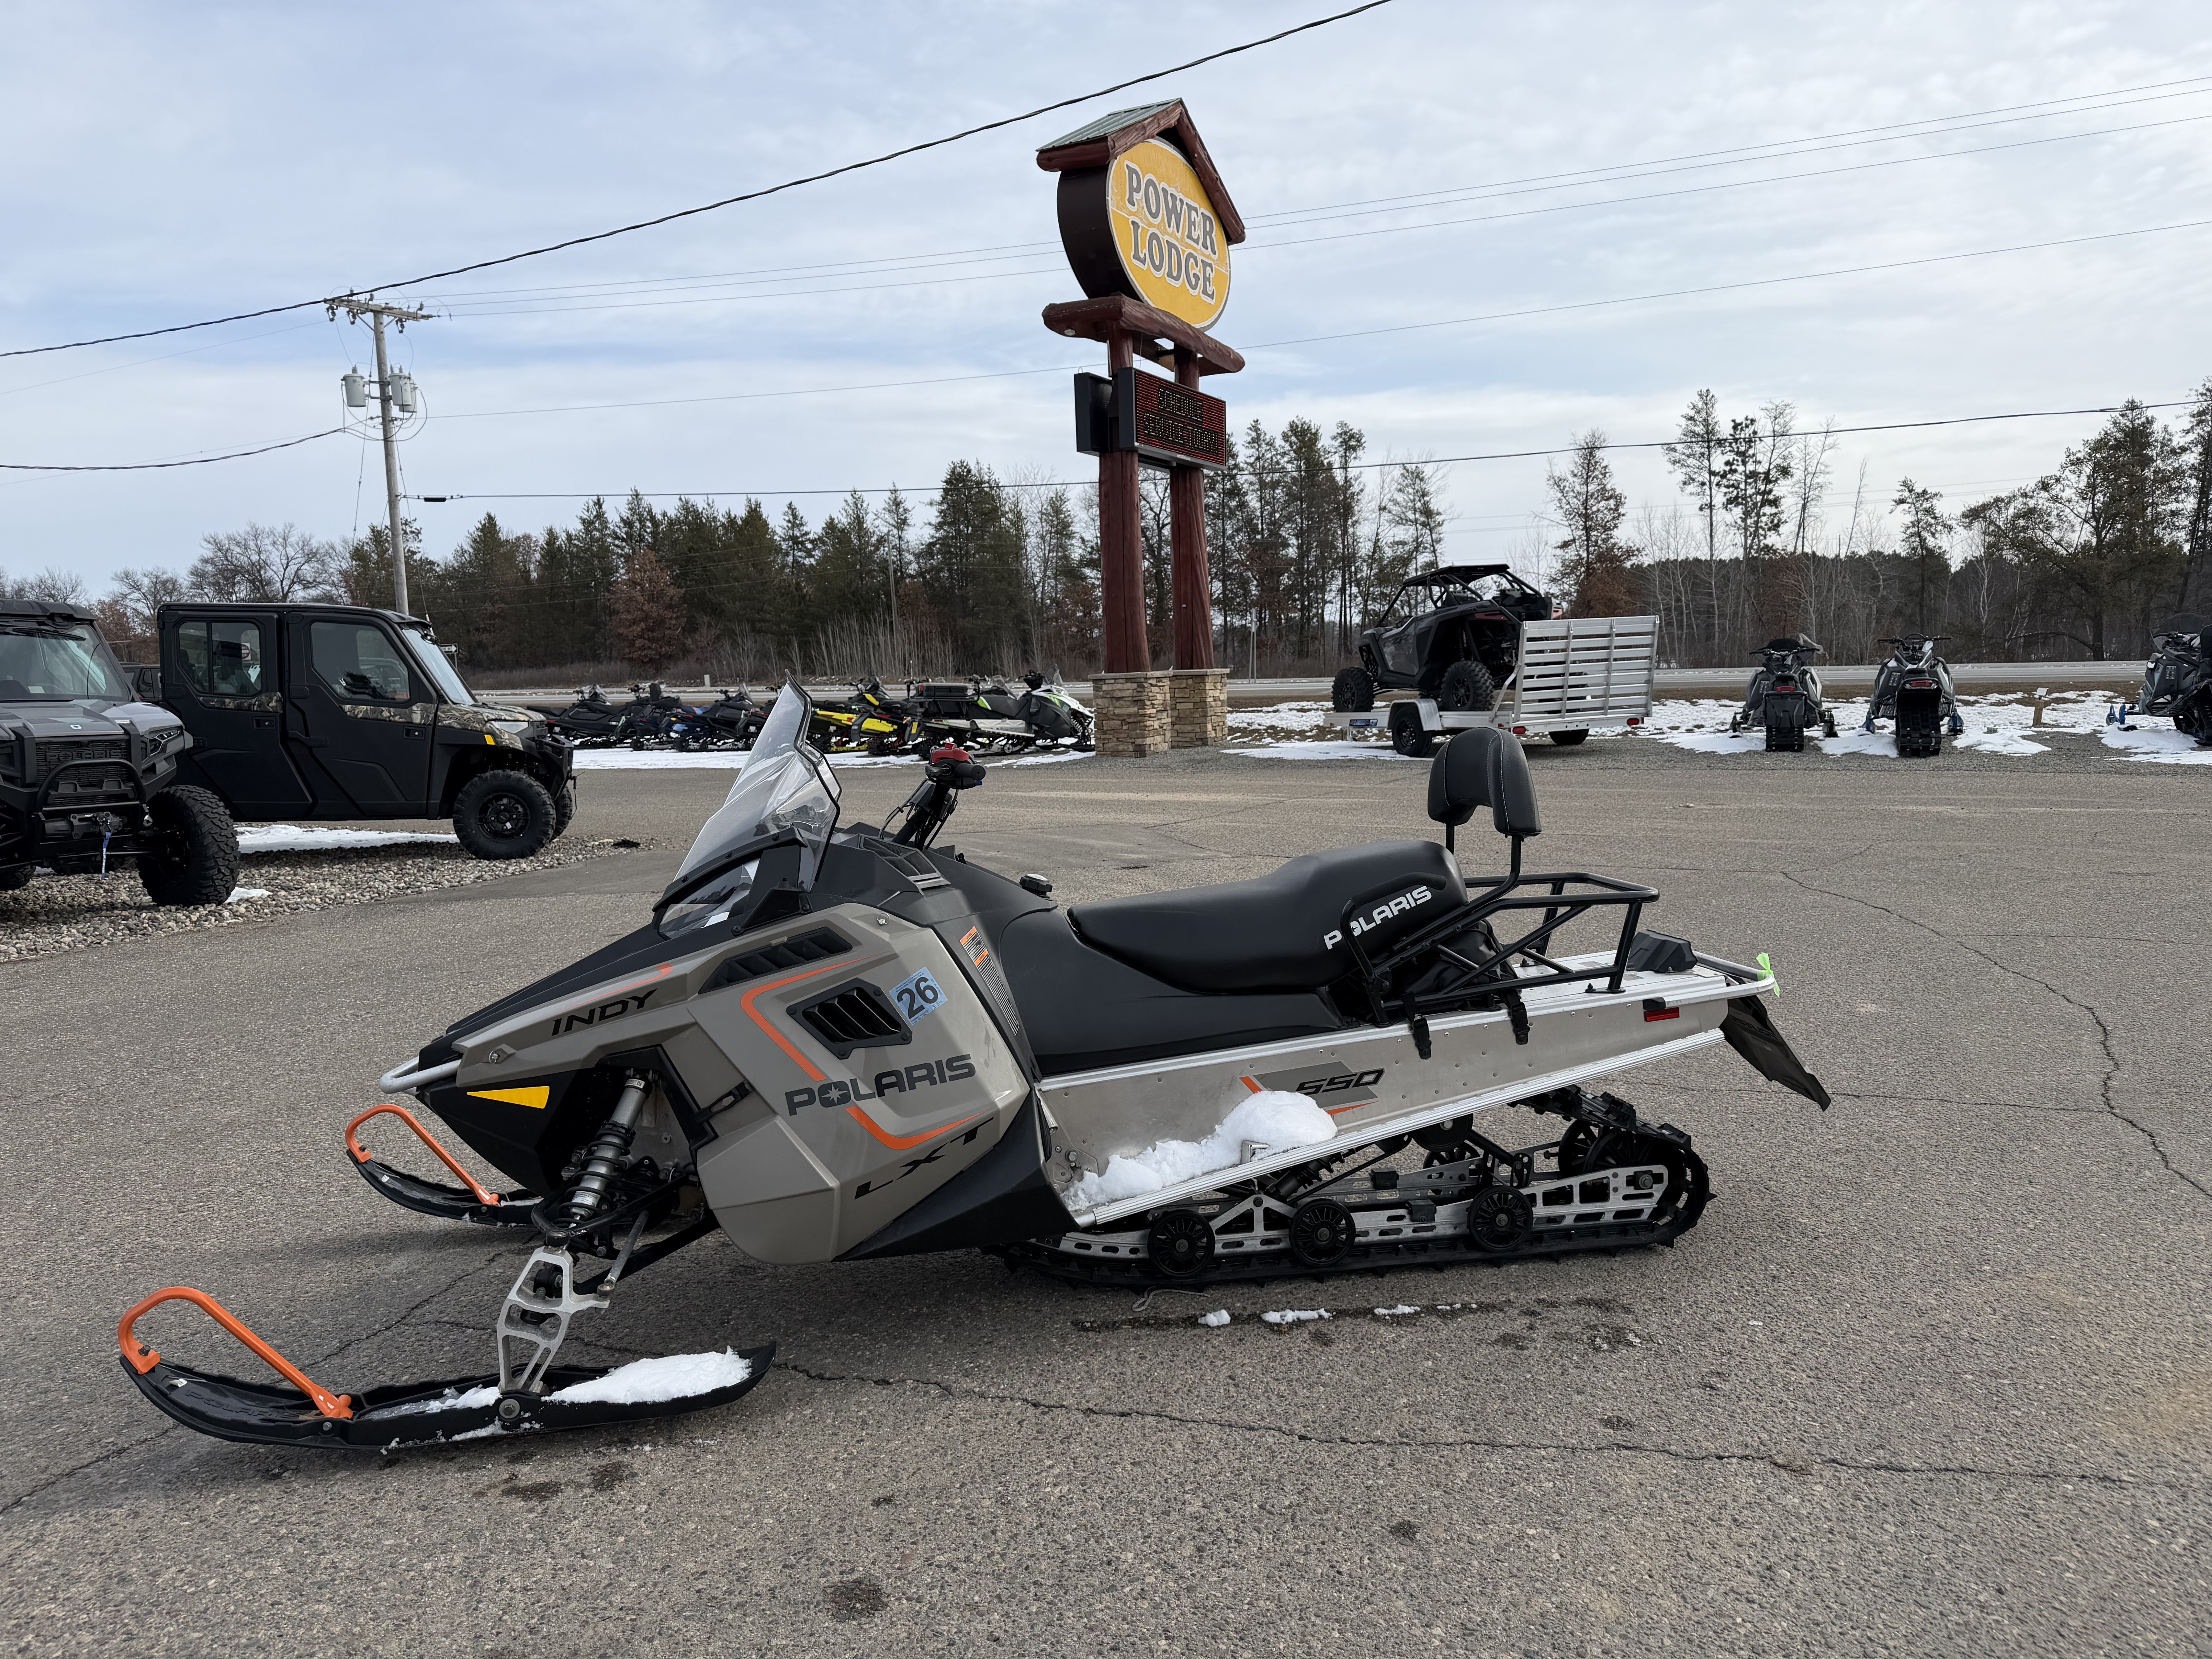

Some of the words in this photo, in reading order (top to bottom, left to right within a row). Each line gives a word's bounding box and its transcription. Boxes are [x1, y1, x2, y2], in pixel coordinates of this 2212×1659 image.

[1125, 161, 1218, 258] POWER
[1130, 219, 1215, 303] LODGE
[46, 749, 122, 761] POLARIS
[1323, 885, 1432, 950] POLARIS
[551, 988, 658, 1036] INDY
[896, 976, 939, 1020] 26
[784, 1053, 976, 1116] POLARIS
[1295, 1067, 1385, 1096] 550
[854, 1117, 994, 1200] LXT
[184, 1389, 300, 1420] POLARIS
